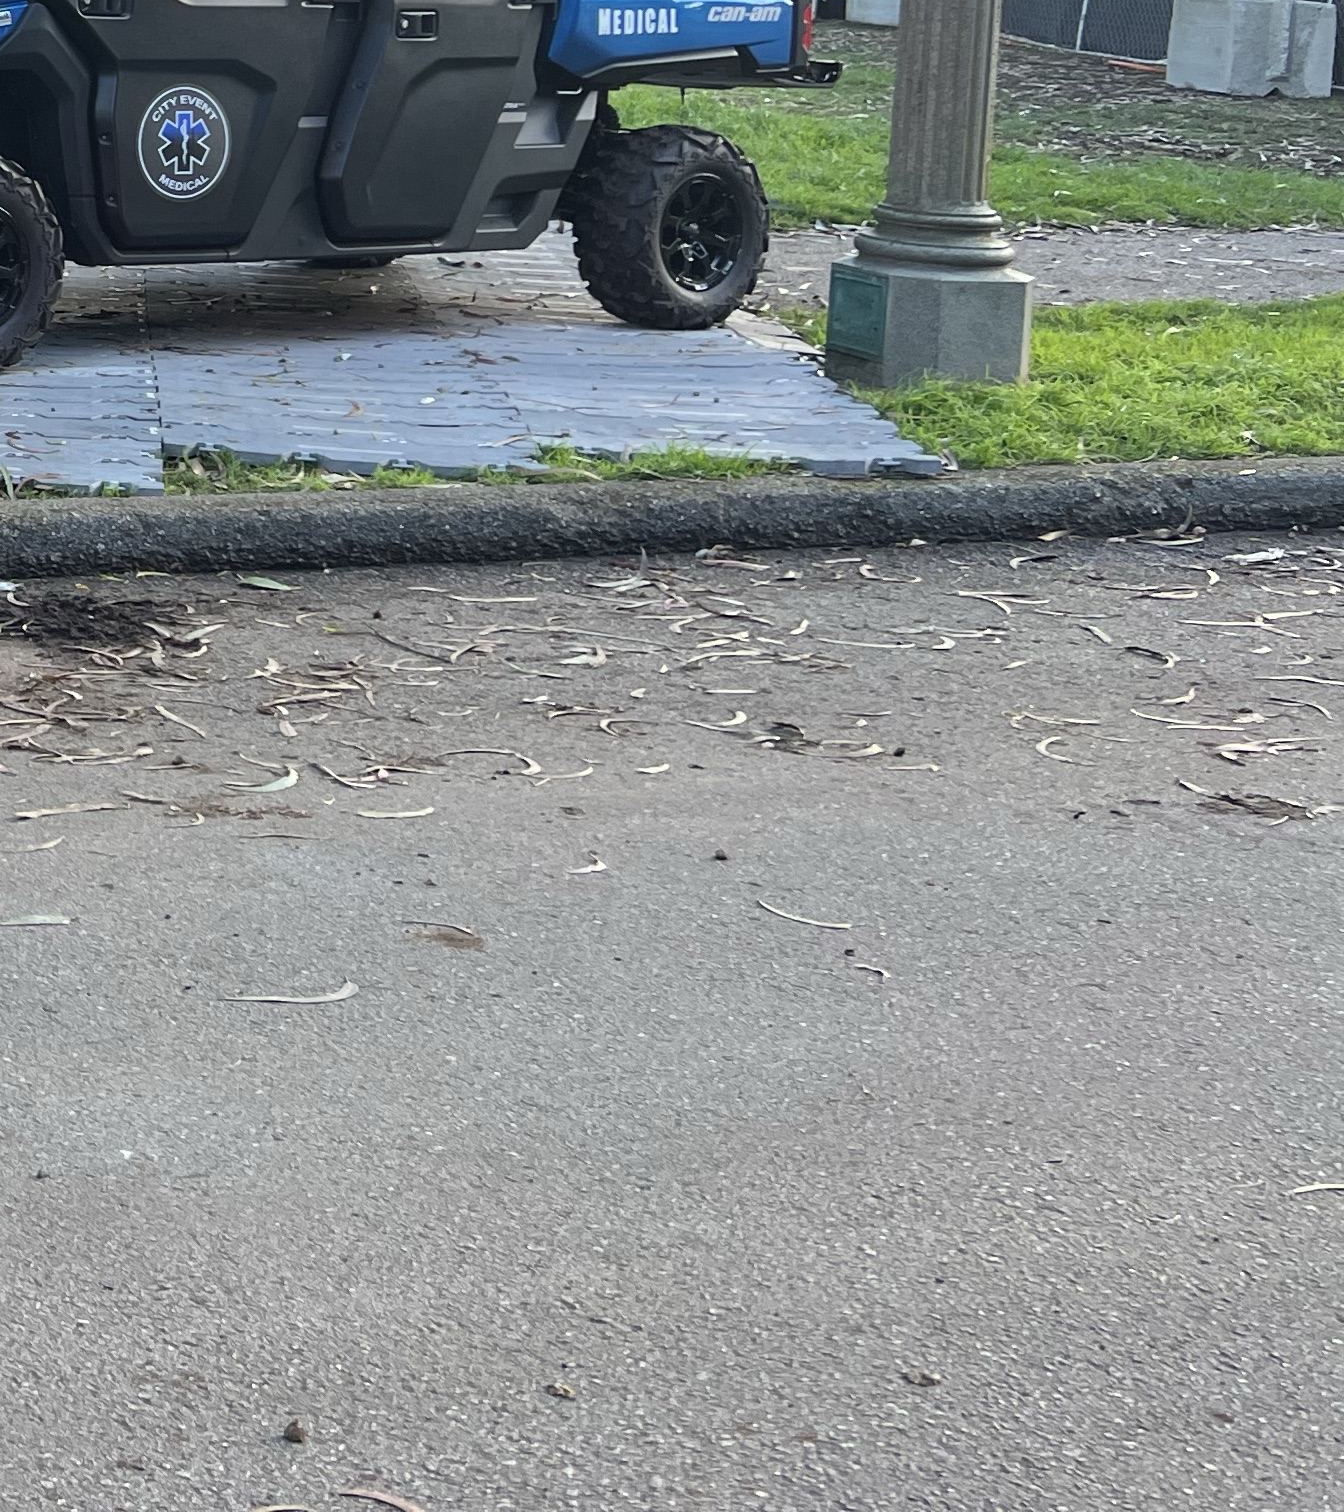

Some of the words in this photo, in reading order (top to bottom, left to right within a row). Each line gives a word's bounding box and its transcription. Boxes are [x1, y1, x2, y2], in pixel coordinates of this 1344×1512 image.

[598, 7, 679, 36] MEDICAL
[707, 6, 782, 22] can-am
[152, 96, 178, 122] CITY
[180, 94, 218, 120] EVENT
[158, 174, 209, 191] MEDICAL
